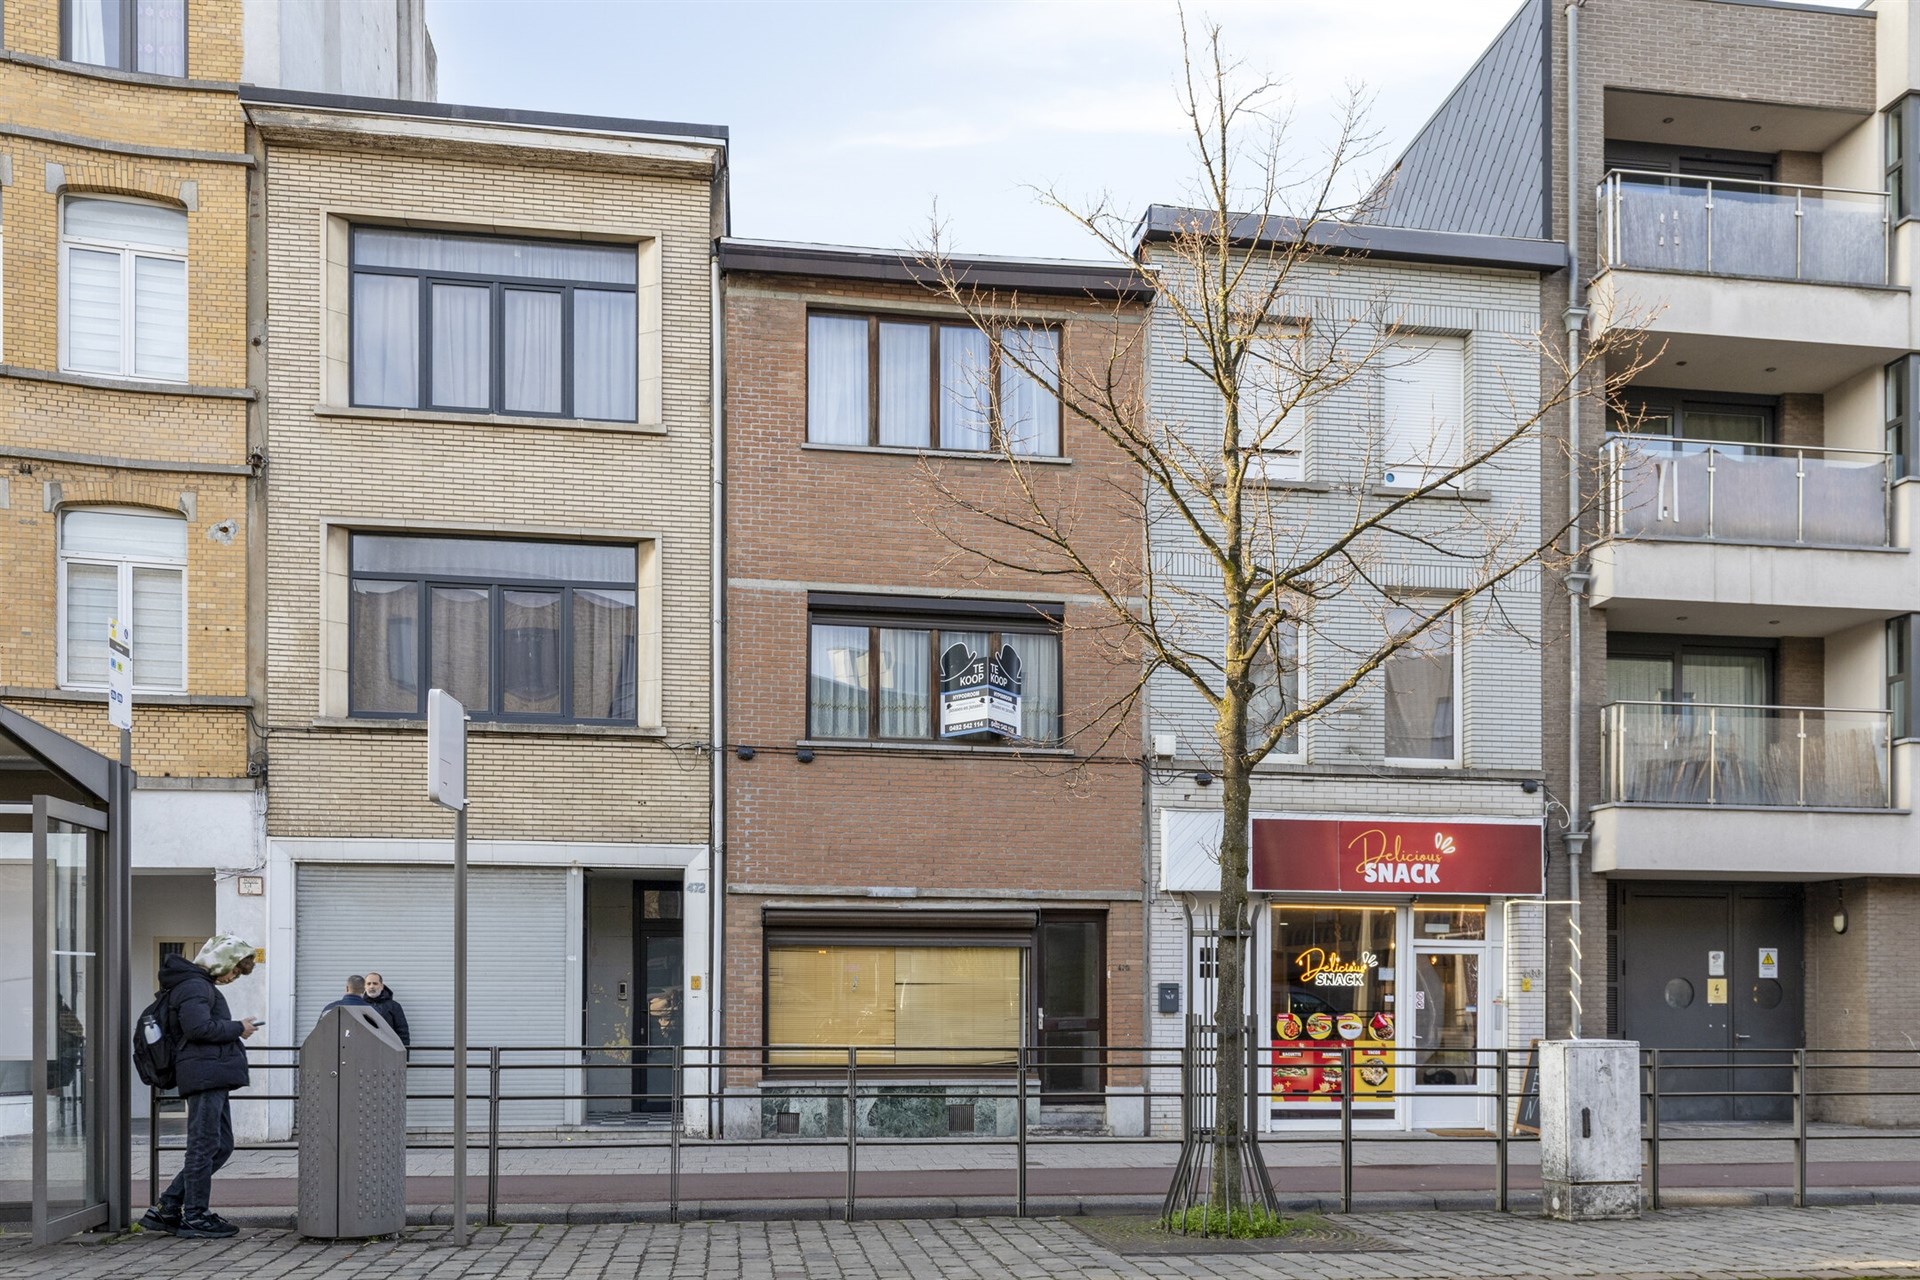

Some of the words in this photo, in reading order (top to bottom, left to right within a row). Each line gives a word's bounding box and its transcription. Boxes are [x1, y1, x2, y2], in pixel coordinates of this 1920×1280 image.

[973, 663, 984, 673] TE
[990, 663, 999, 675] TE
[960, 674, 984, 686] KOOP
[990, 673, 1008, 687] KOOP
[1348, 829, 1442, 874] Delicious
[1364, 863, 1441, 884] SNACK
[1295, 947, 1367, 982] Delicious
[1315, 973, 1364, 986] SNACK
